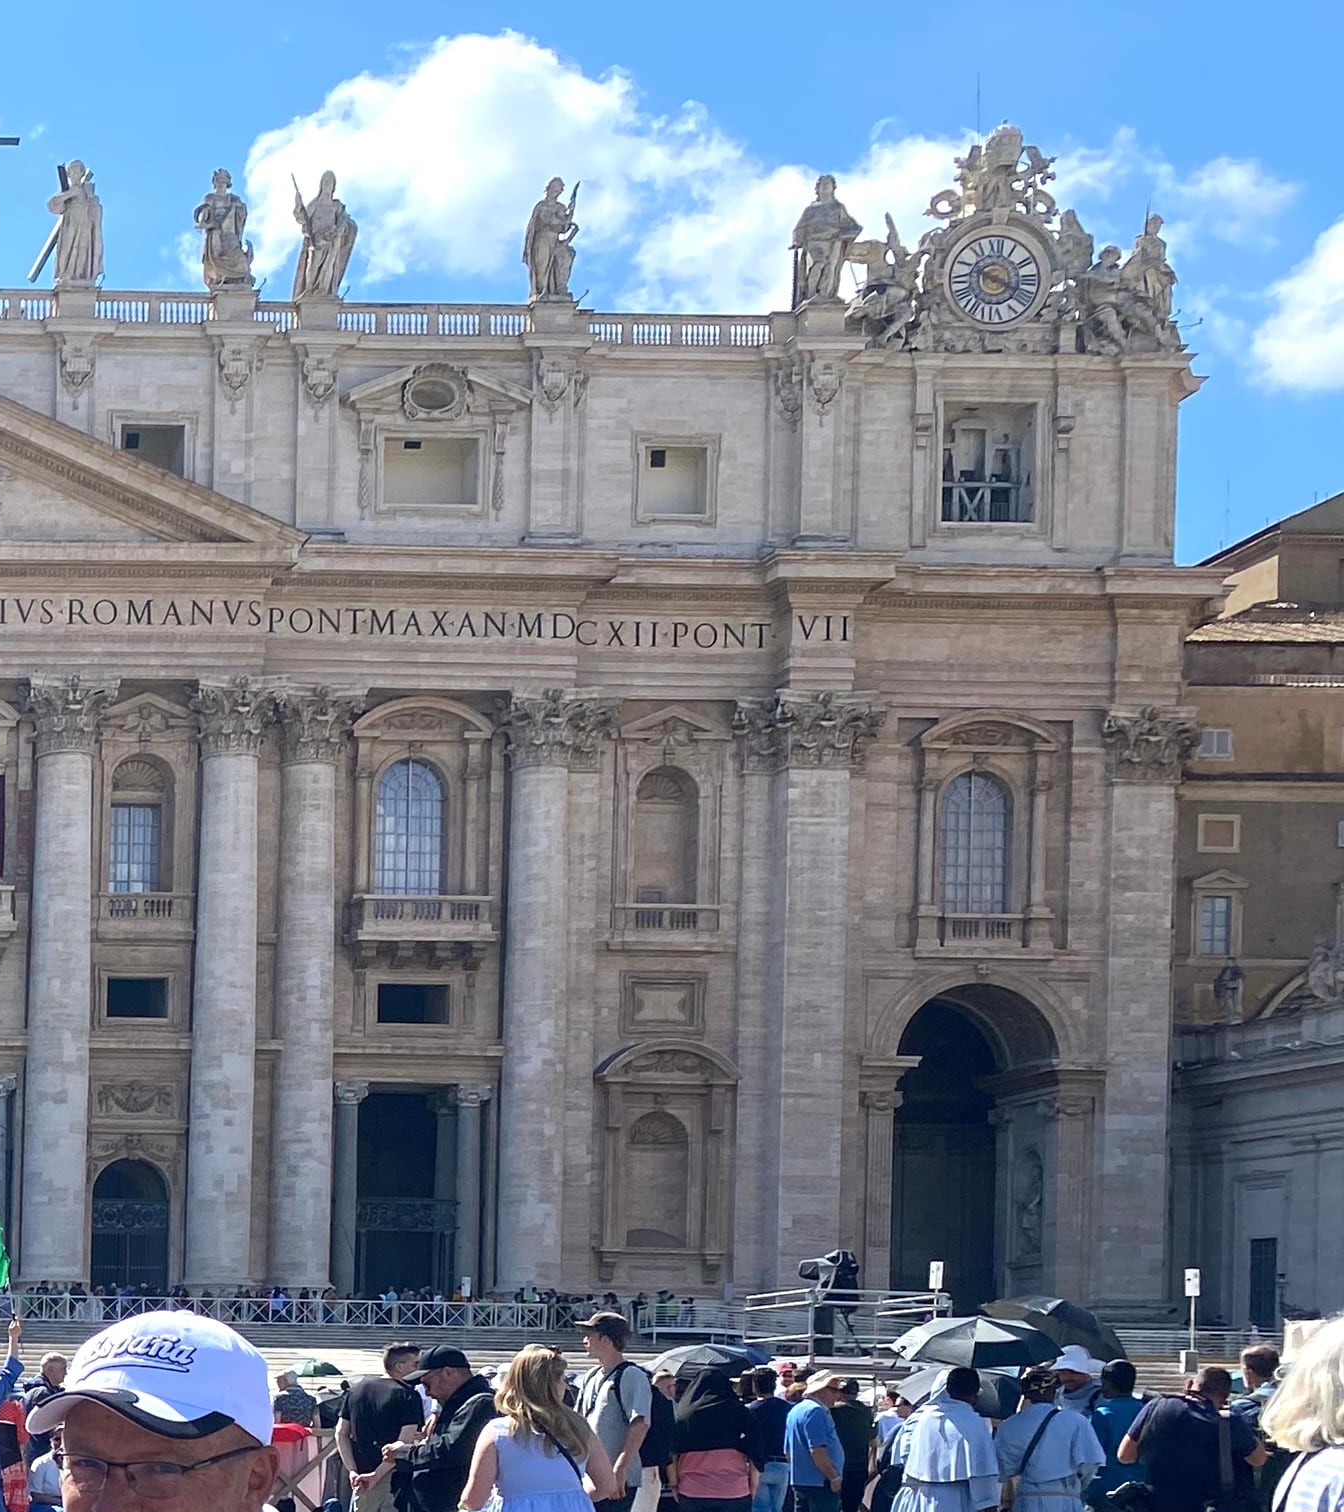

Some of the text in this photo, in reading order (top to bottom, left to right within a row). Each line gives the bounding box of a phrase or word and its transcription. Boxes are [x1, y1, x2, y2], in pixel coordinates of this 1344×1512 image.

[66, 599, 262, 626] ROMANVS
[268, 607, 364, 634] PONT
[368, 609, 451, 637] MAX
[457, 611, 508, 639] AN
[671, 622, 772, 649] PONT
[798, 615, 850, 642] VII
